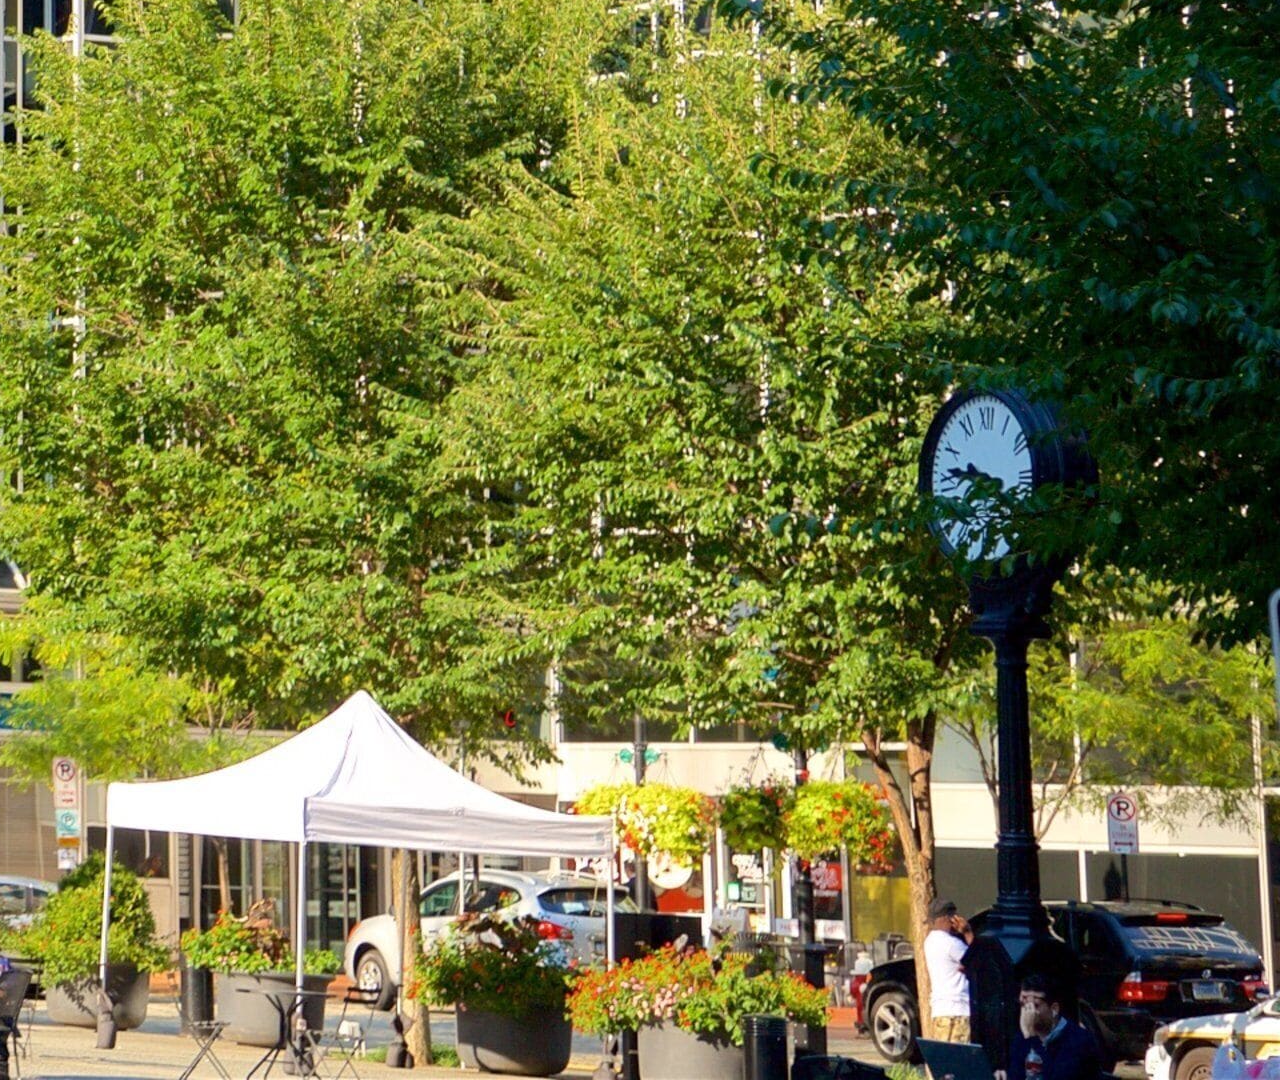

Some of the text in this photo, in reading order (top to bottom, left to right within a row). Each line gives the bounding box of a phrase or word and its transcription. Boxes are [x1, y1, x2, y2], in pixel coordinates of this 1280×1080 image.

[958, 413, 974, 441] XI
[979, 407, 995, 431] XII
[944, 441, 961, 462] X
